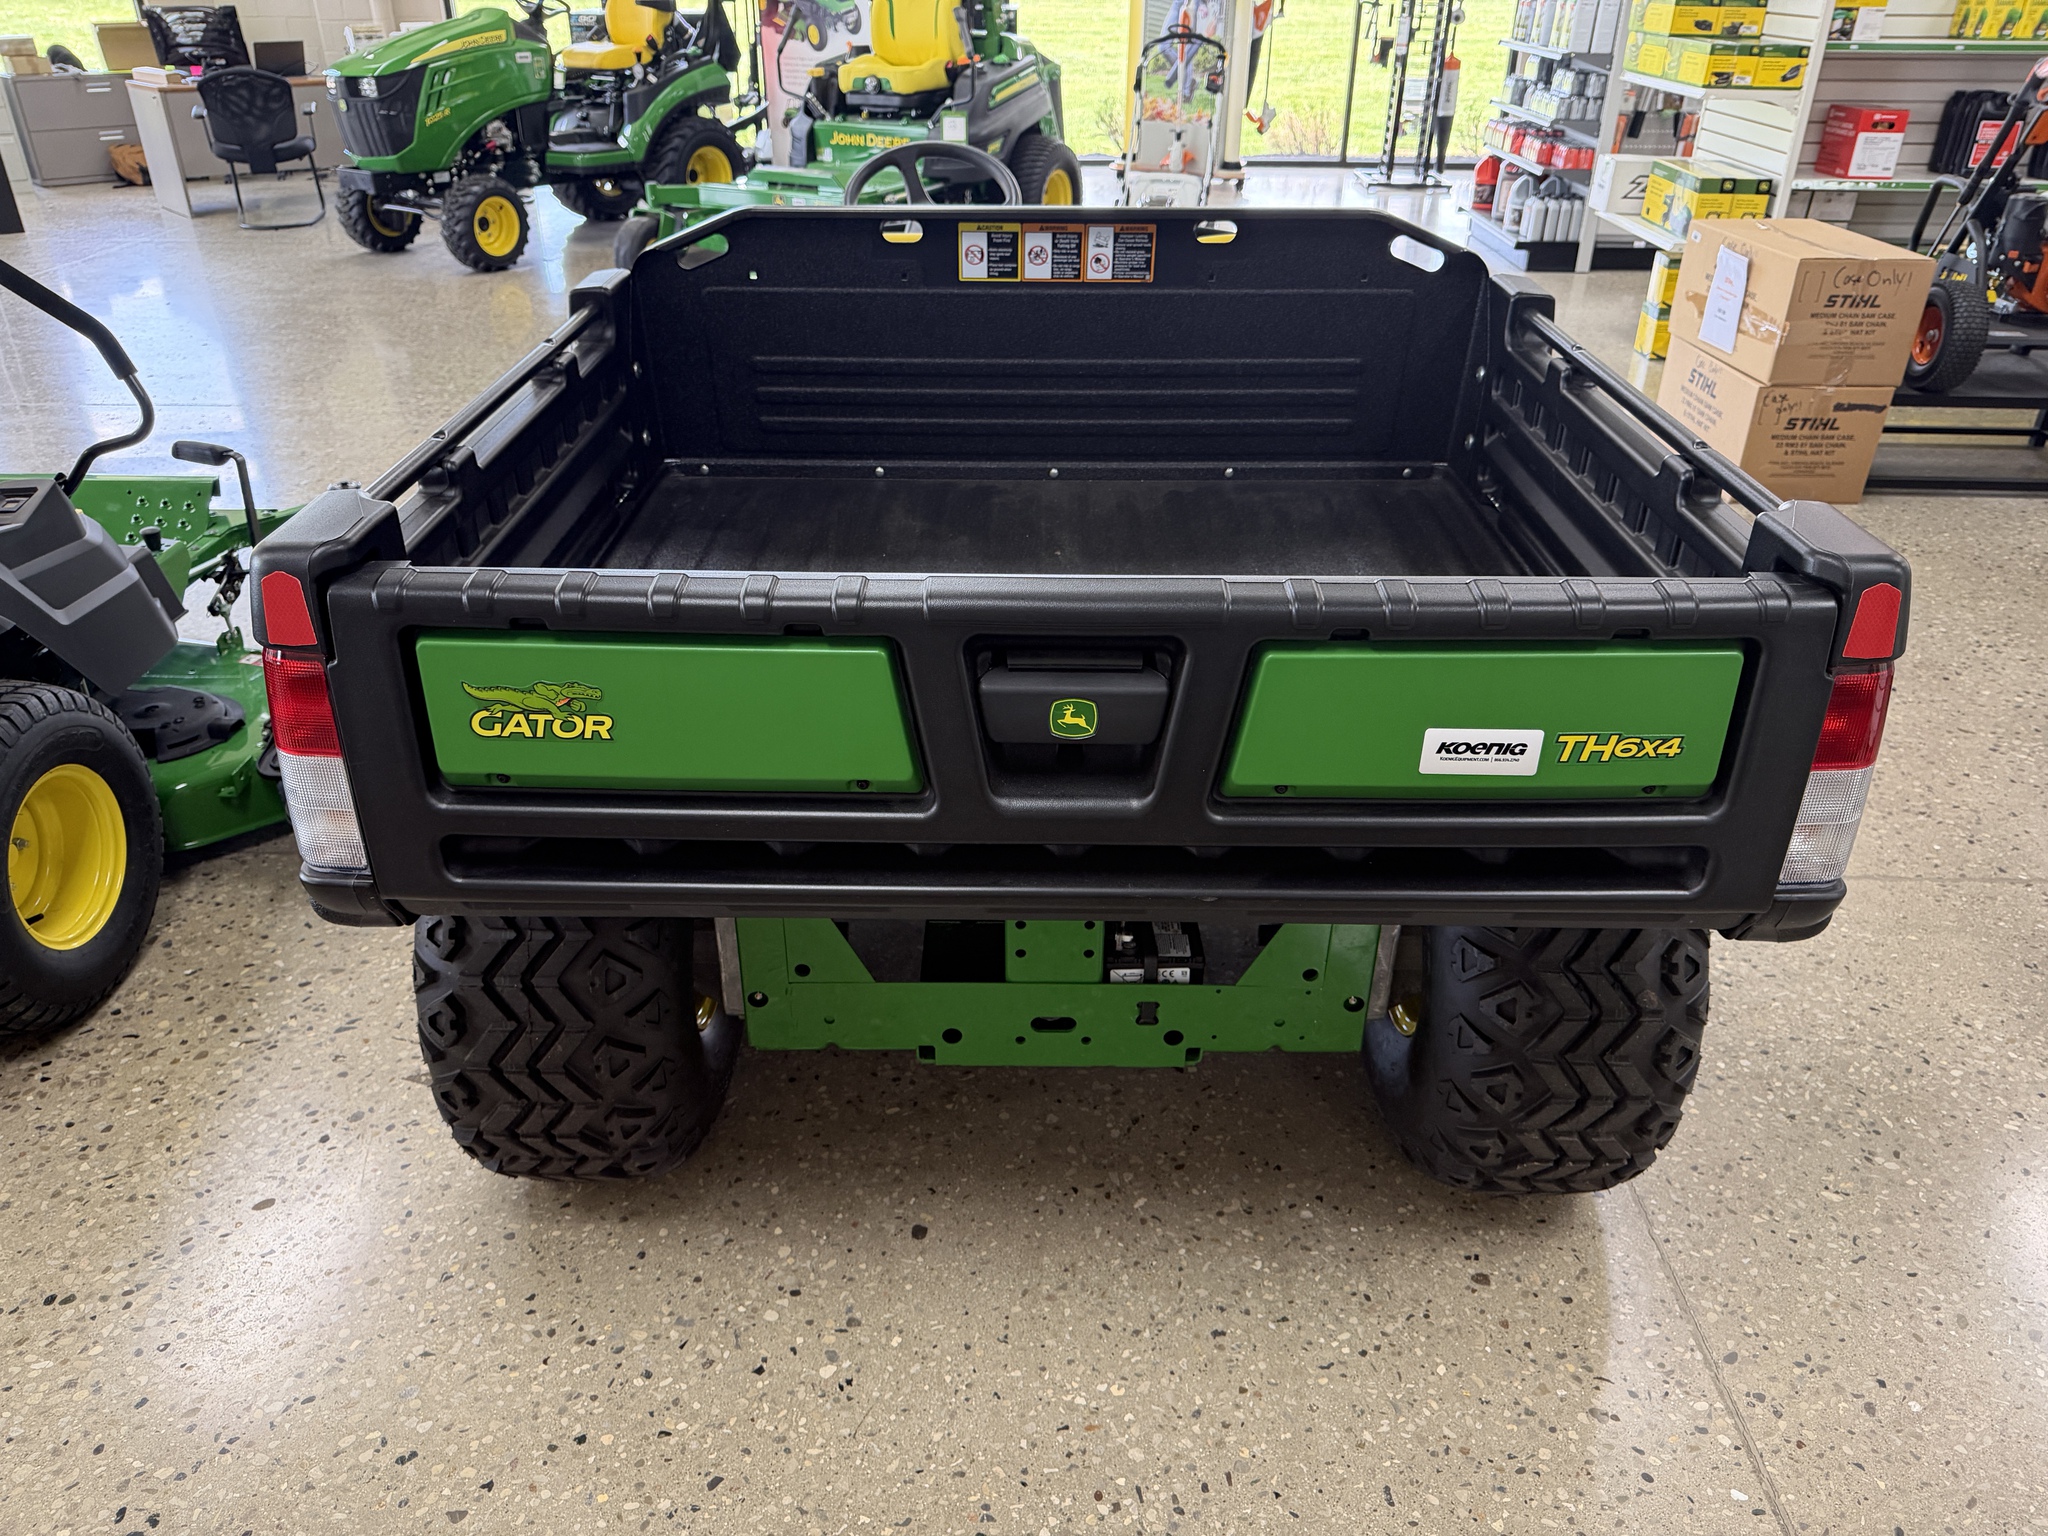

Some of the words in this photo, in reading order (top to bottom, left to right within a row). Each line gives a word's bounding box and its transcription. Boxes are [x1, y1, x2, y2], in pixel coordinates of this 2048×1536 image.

[829, 130, 864, 147] JOHN
[1833, 266, 1862, 289] Case
[1867, 268, 1913, 297] Only!
[1823, 294, 1881, 308] STIHL
[1688, 367, 1717, 399] STIHL
[1783, 418, 1840, 431] STIHL
[469, 709, 614, 740] GATOR
[1556, 734, 1684, 763] TH6x4
